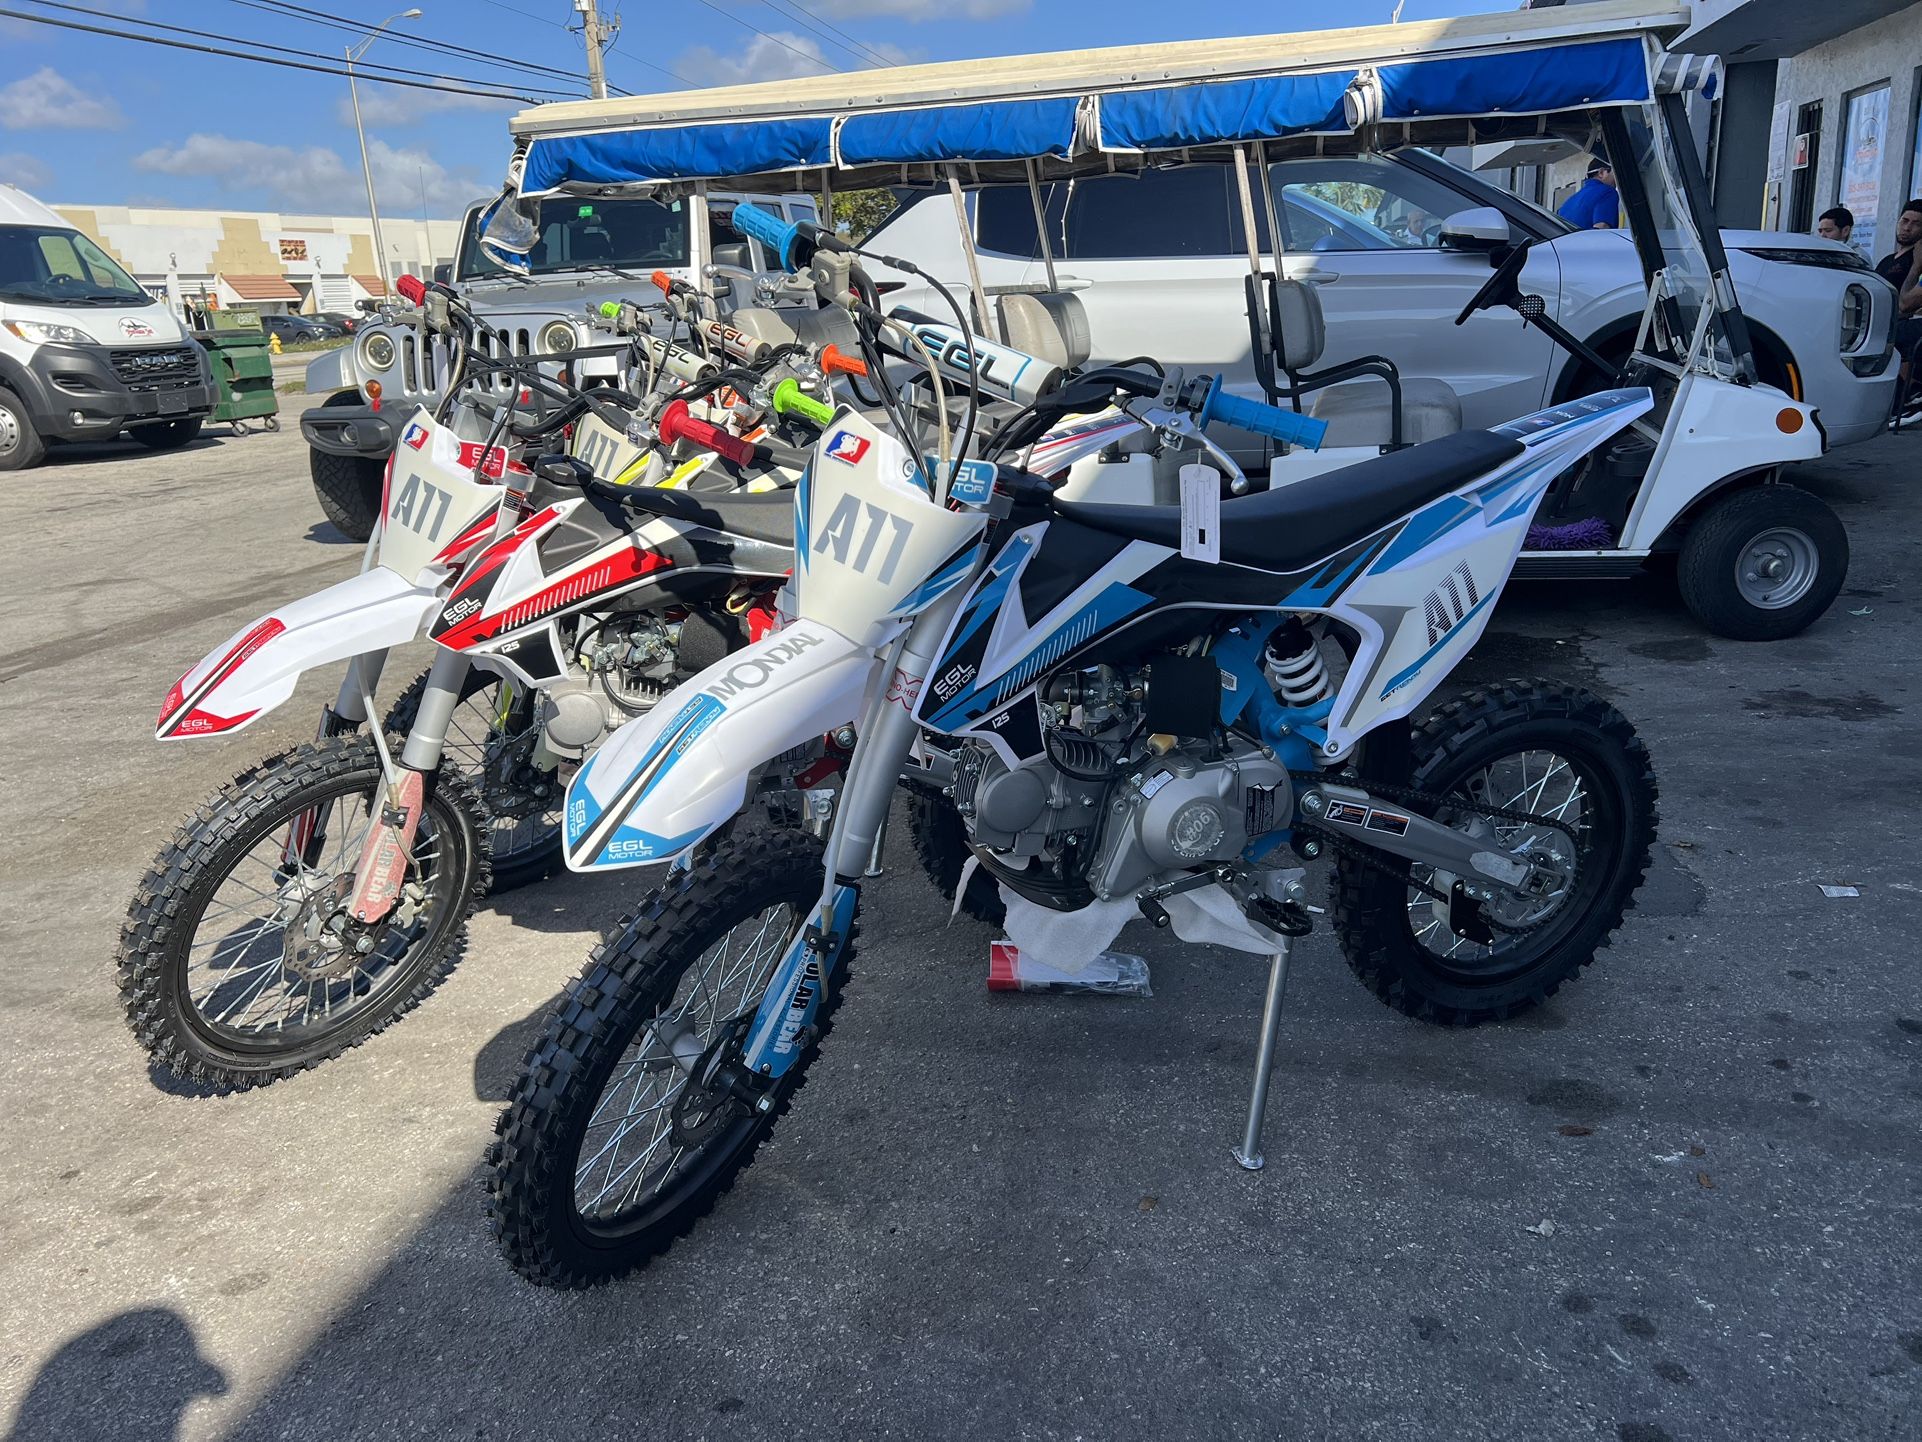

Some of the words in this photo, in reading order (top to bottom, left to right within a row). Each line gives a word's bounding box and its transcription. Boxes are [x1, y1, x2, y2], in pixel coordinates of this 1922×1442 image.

[710, 322, 747, 348] EGL
[652, 339, 691, 365] EGL
[911, 326, 1010, 391] EGL
[442, 597, 480, 621] EGL
[447, 601, 483, 627] MOTOR
[500, 640, 520, 654] 125
[706, 632, 825, 702] MONDIAL
[933, 663, 973, 696] EGL
[939, 667, 977, 703] MOTOR
[180, 725, 213, 733] MOTOR
[181, 718, 214, 728] EGL
[991, 711, 1010, 729] 125
[569, 802, 577, 838] MOTOR
[575, 798, 587, 836] EGL
[608, 839, 653, 853] EGL
[608, 849, 653, 861] MOTOR
